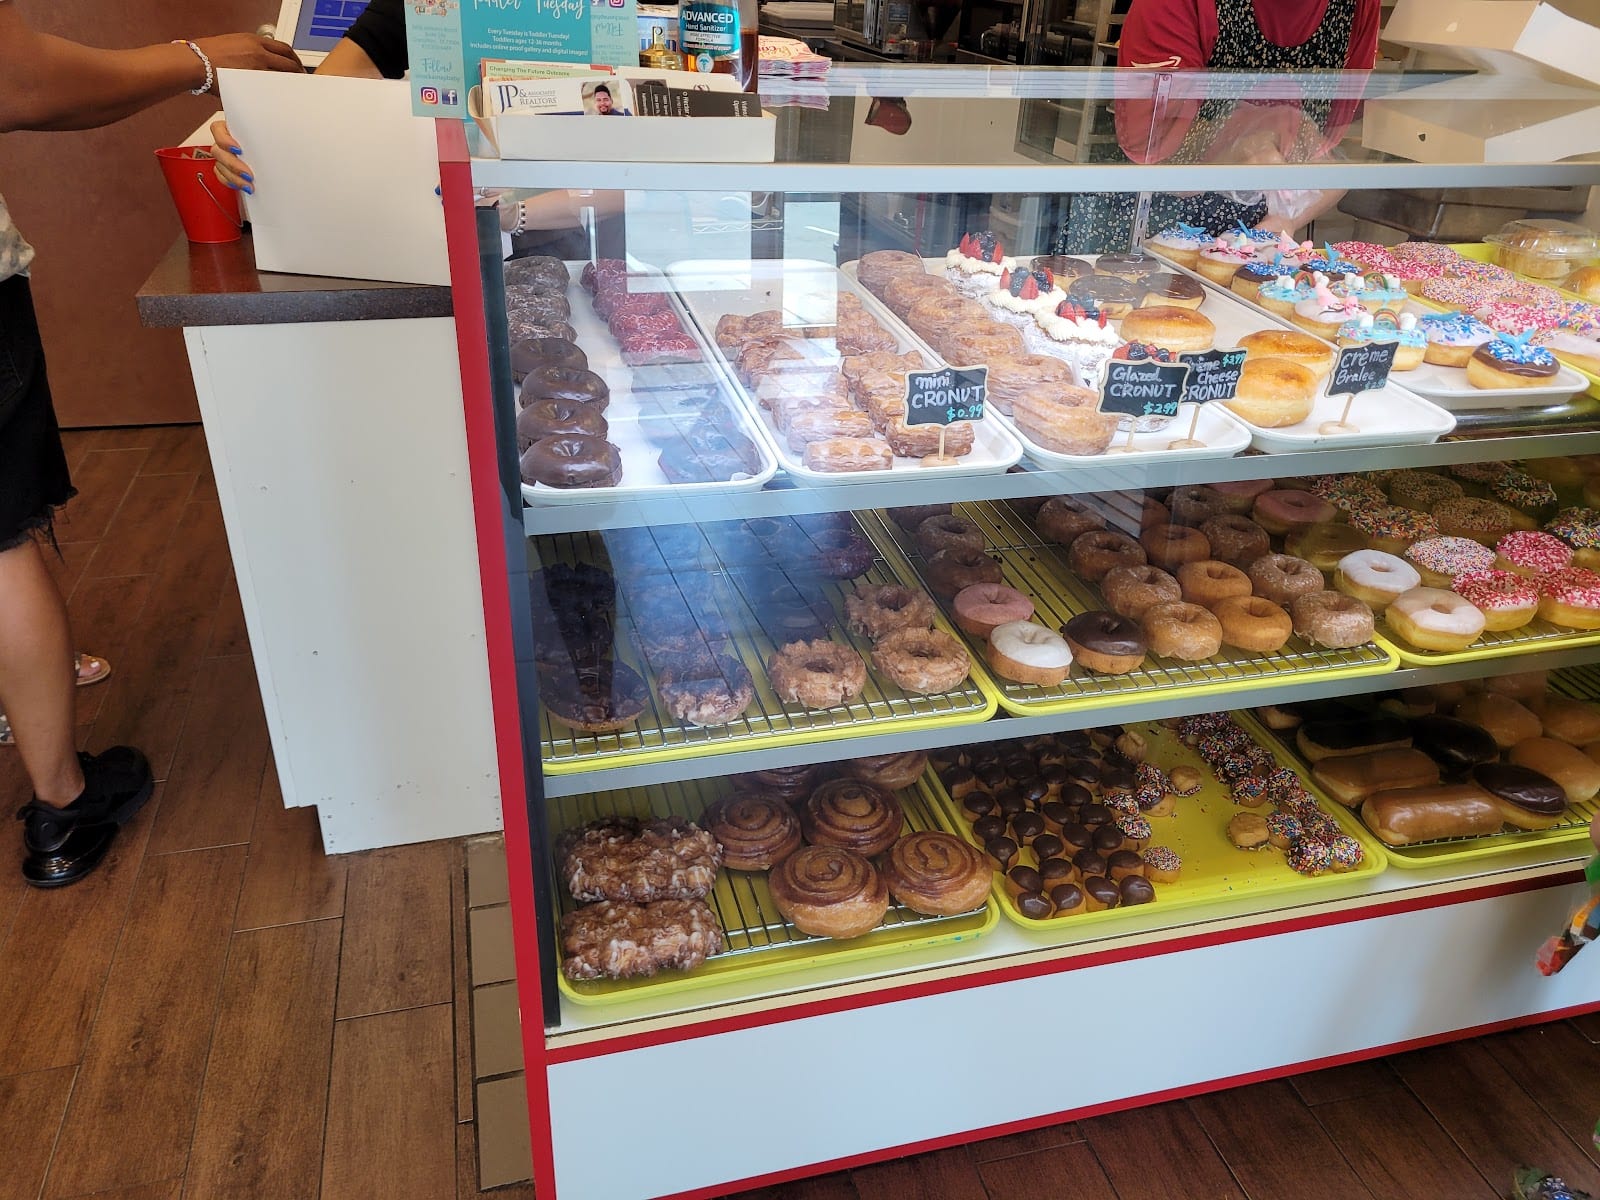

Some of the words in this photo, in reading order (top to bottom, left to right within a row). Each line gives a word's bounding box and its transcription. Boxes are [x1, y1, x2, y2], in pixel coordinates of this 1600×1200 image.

[682, 10, 734, 24] ADVANCED
[487, 27, 502, 36] Every
[686, 23, 698, 31] Hand
[700, 24, 727, 32] Sanitizer
[489, 65, 516, 74] Changing
[497, 84, 519, 114] JP
[520, 88, 527, 97] &
[520, 97, 558, 105] REALTORS
[915, 371, 951, 390] mini
[1112, 366, 1162, 383] Glazed
[1197, 370, 1239, 385] Cheese
[911, 385, 985, 409] CRONUT
[1110, 383, 1178, 398] CRONUT
[1181, 382, 1237, 401] RONUT
[946, 403, 984, 422] $0.99
[1143, 401, 1178, 416] $2.99
